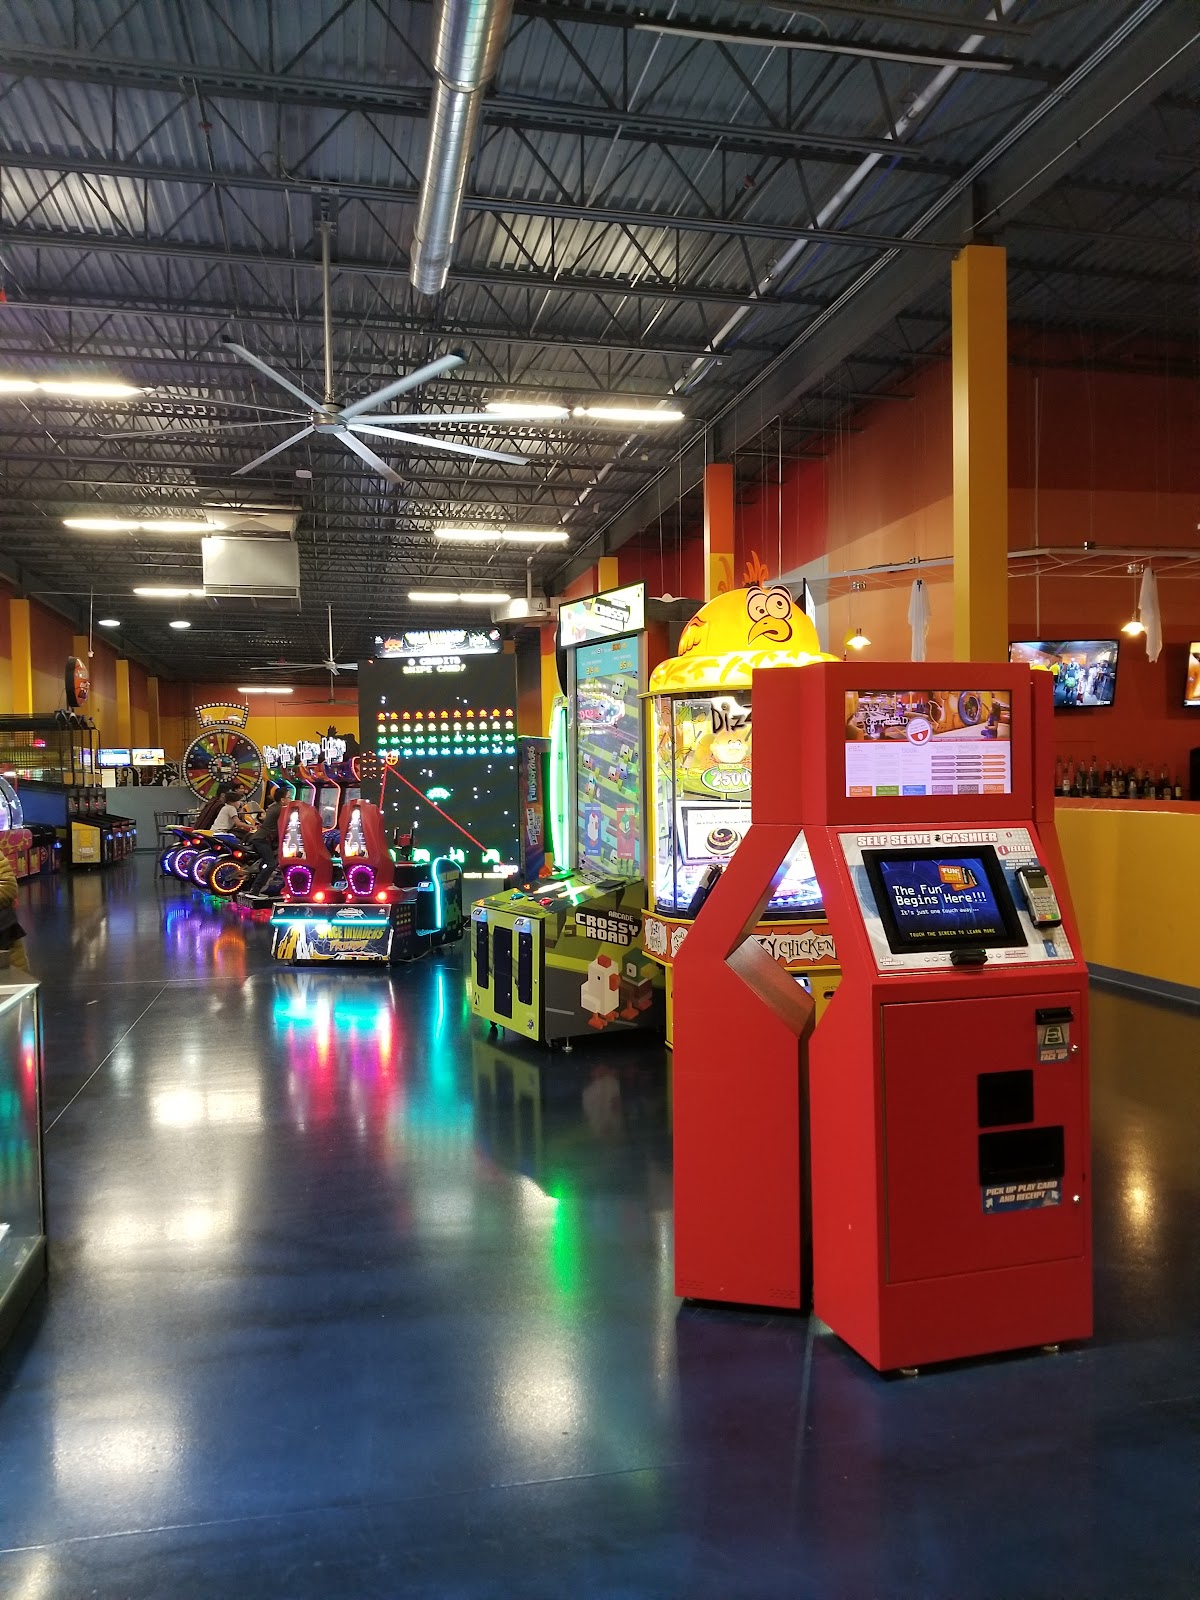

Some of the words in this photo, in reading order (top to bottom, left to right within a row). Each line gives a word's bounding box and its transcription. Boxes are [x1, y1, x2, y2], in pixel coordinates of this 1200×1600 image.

[711, 769, 752, 787] 2500
[857, 835, 887, 847] SELF
[891, 834, 931, 845] SERVE
[942, 832, 998, 844] CASHIER
[893, 885, 916, 897] The
[921, 884, 943, 895] Fun
[896, 895, 939, 908] Begins
[945, 892, 988, 904] Here!!!
[608, 910, 634, 922] ARCADE
[901, 908, 915, 916] It's
[916, 908, 930, 916] just
[575, 912, 640, 937] CROSSY
[343, 926, 386, 939] INVADERS
[586, 929, 629, 946] ROAD
[986, 1186, 1005, 1197] PICK
[1006, 1185, 1017, 1195] UP
[1018, 1183, 1036, 1193] PLAY
[1037, 1181, 1058, 1191] CARD
[999, 1194, 1016, 1204] AND
[1016, 1191, 1046, 1201] RECEIPT
